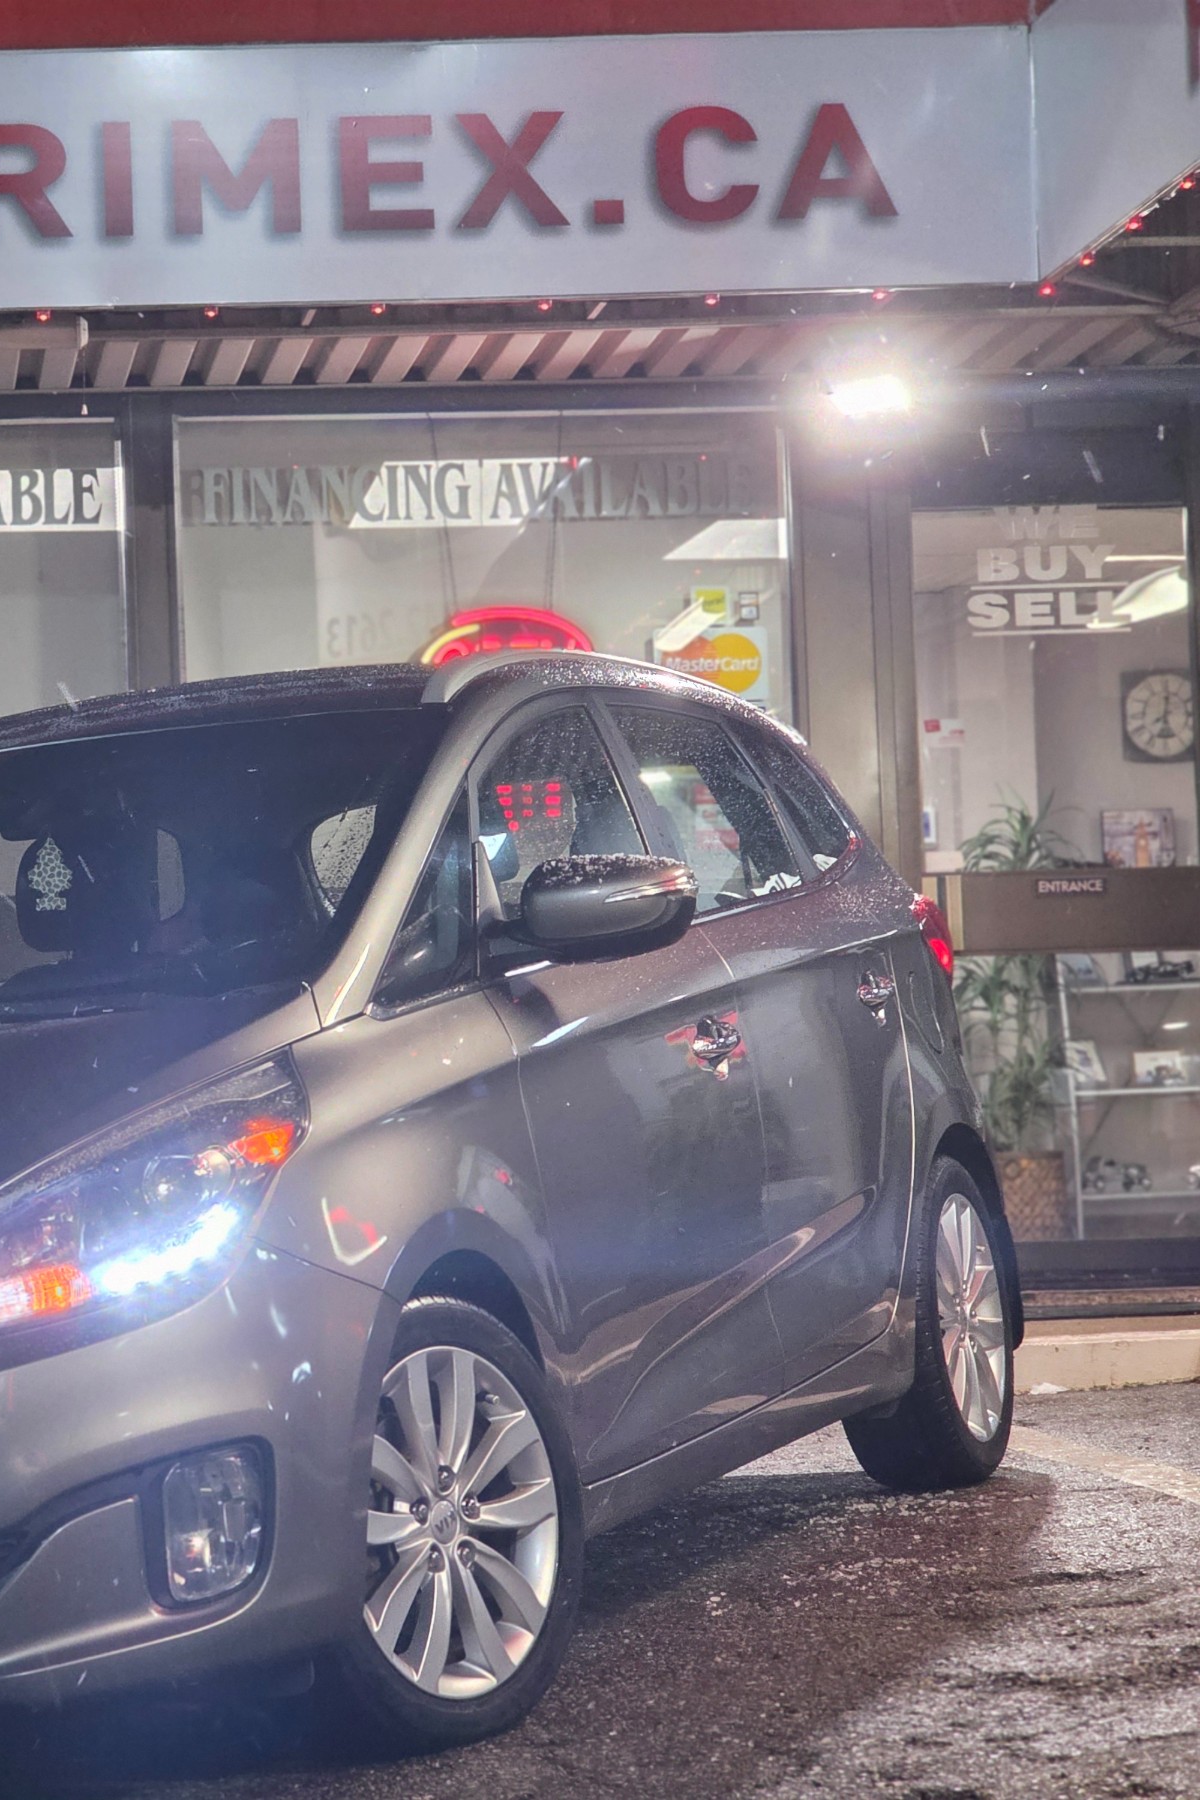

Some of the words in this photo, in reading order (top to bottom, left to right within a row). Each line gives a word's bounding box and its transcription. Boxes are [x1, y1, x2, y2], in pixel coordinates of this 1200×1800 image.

[203, 462, 471, 525] FINANCING
[490, 458, 753, 521] AVAILABLE
[993, 504, 1100, 540] WE
[977, 544, 1115, 583] BUY
[967, 590, 1132, 629] SELL
[666, 656, 759, 672] MasterCard
[1038, 880, 1103, 893] ENTRANCE
